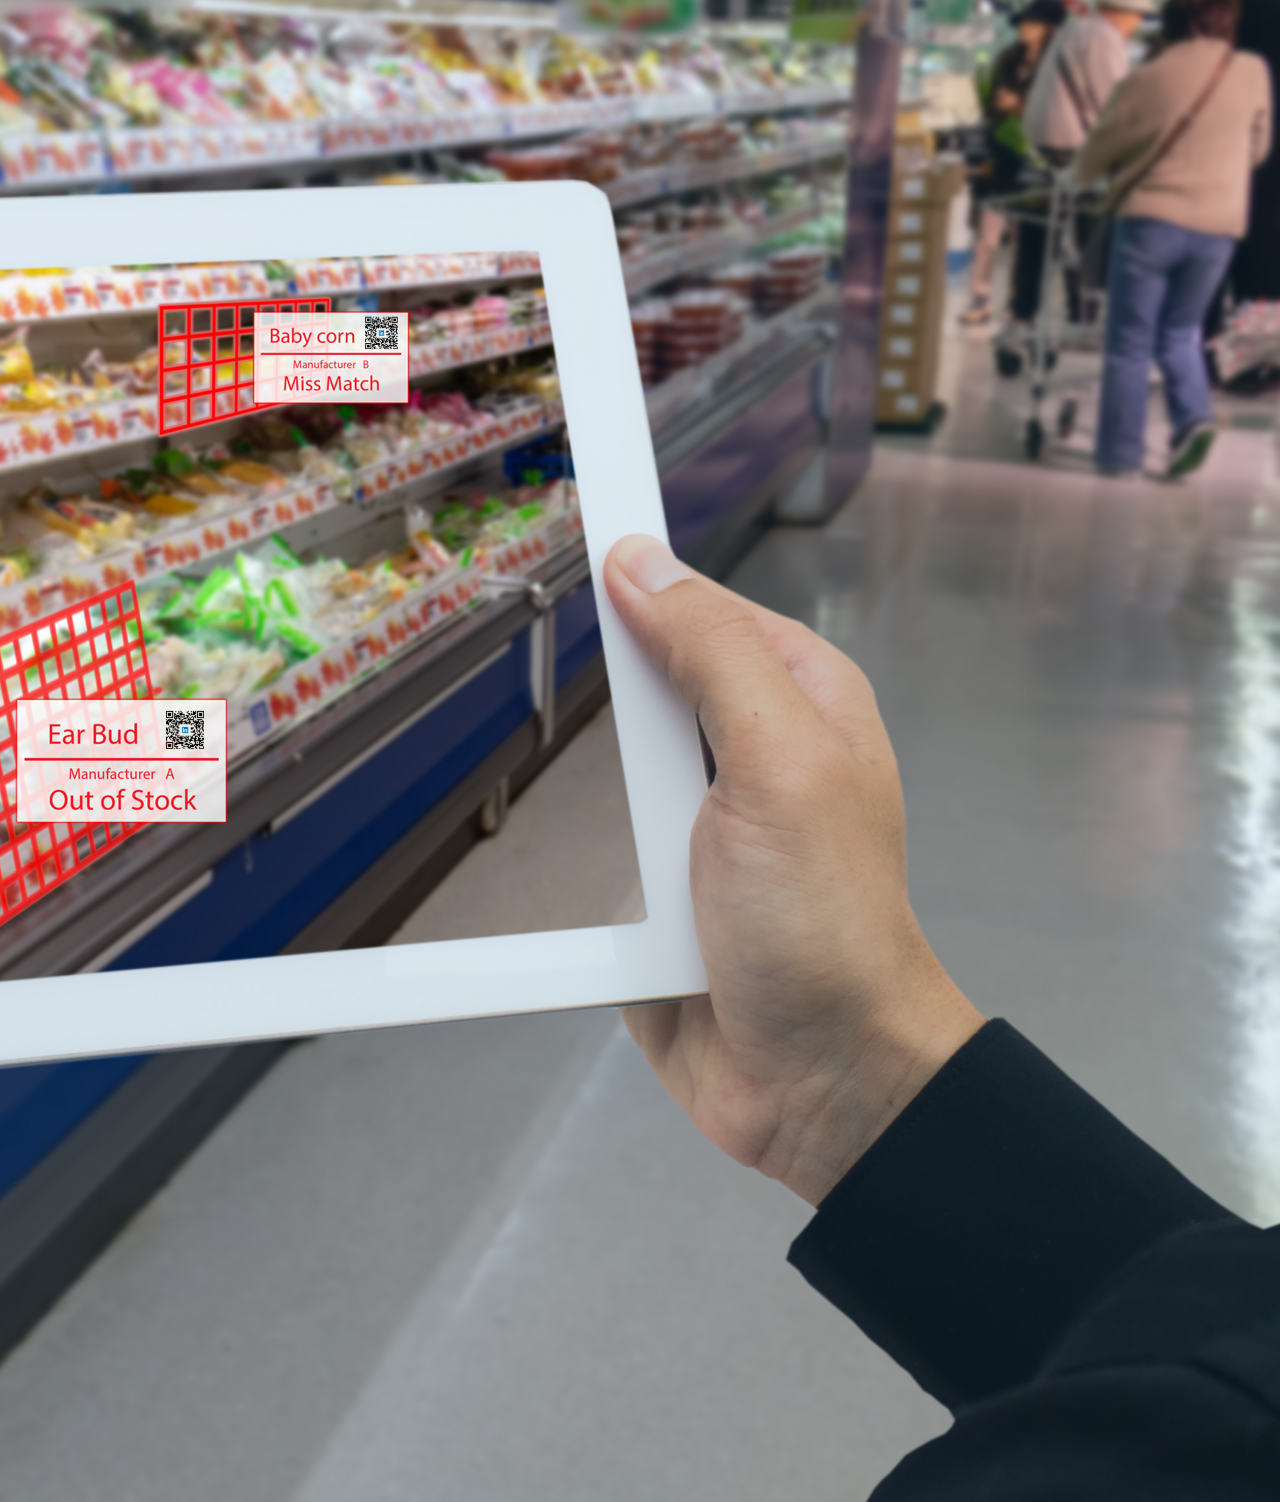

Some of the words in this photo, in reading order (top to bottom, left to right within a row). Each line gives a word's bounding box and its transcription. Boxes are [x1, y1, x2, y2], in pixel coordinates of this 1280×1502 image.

[270, 327, 312, 347] Baby
[317, 332, 354, 343] corn
[293, 360, 356, 369] Manufacturer
[363, 360, 369, 368] B
[284, 376, 321, 391] Miss
[327, 375, 379, 391] Match
[49, 724, 85, 744] Ear
[93, 723, 137, 744] Bud
[69, 768, 155, 779] Manufacturer
[166, 768, 174, 779] A
[50, 790, 94, 810] Out
[101, 789, 126, 810] of
[132, 789, 196, 810] Stock
